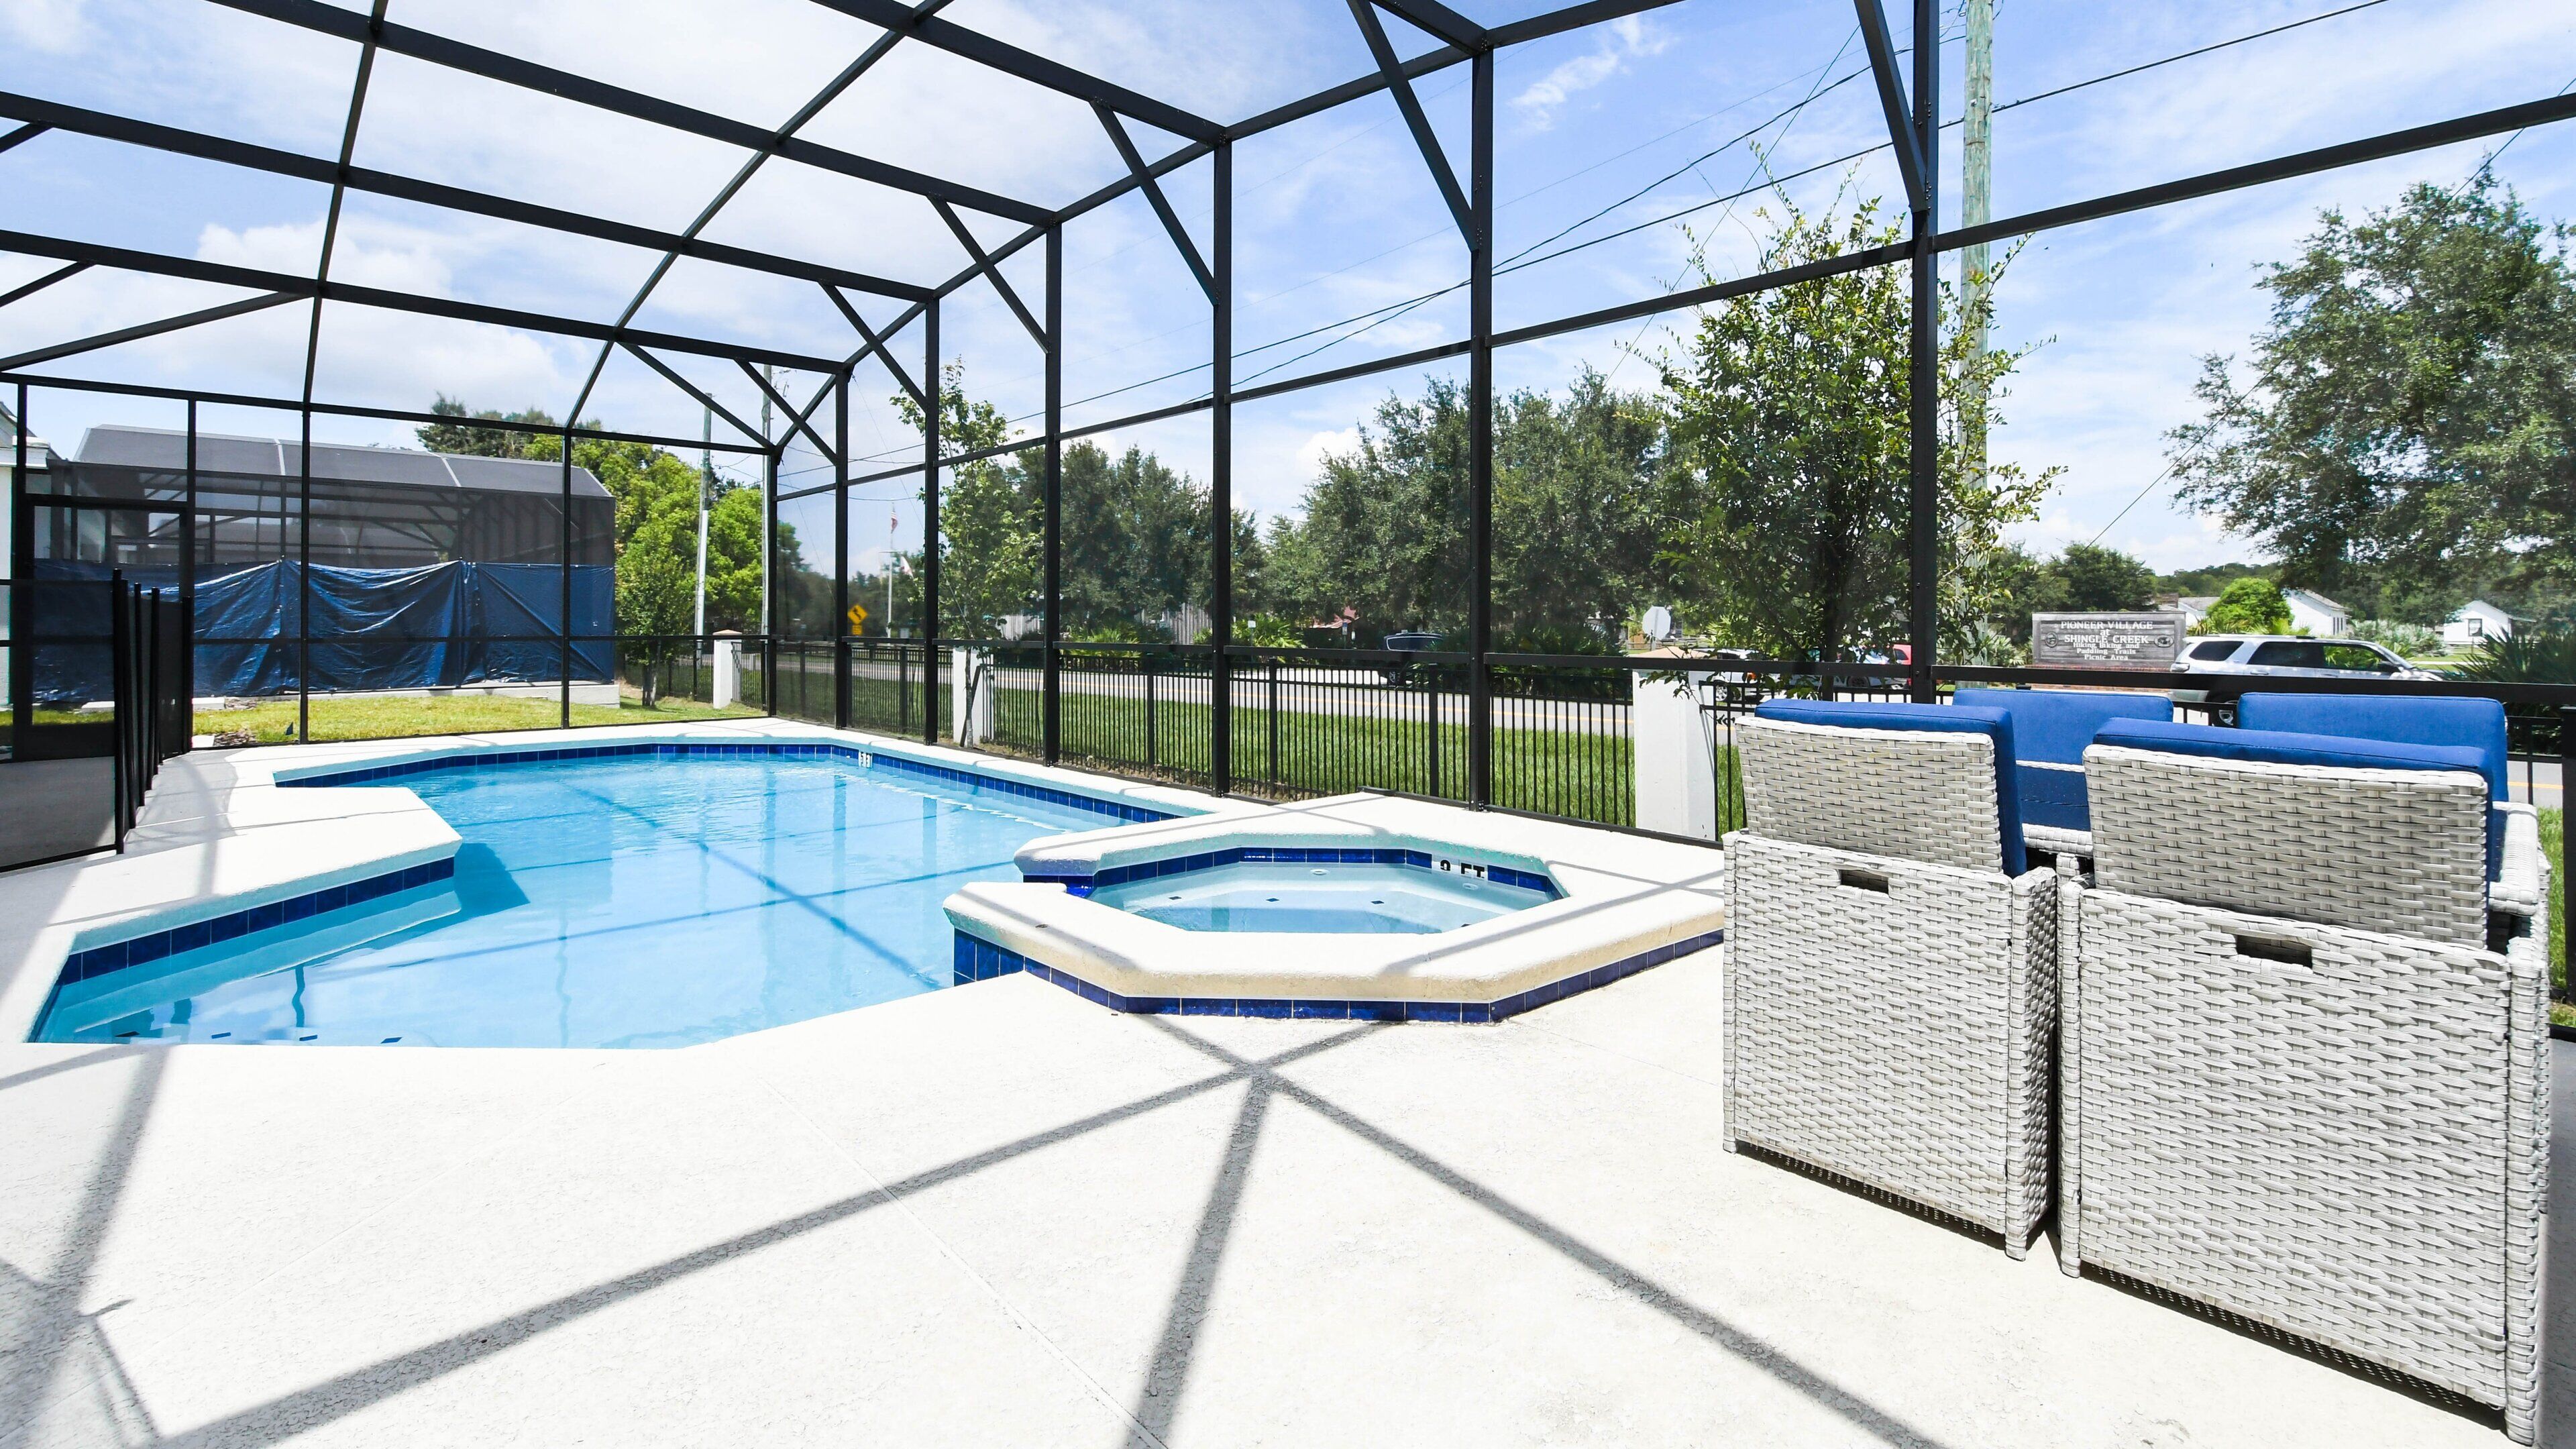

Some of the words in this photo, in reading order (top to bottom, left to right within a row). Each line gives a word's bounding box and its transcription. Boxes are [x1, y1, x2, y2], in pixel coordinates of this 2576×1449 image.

[2061, 621, 2104, 629] PIONEER
[2108, 621, 2153, 629] VILLAGE
[2064, 635, 2108, 643] SHINGLE
[2112, 635, 2149, 643] CREEK
